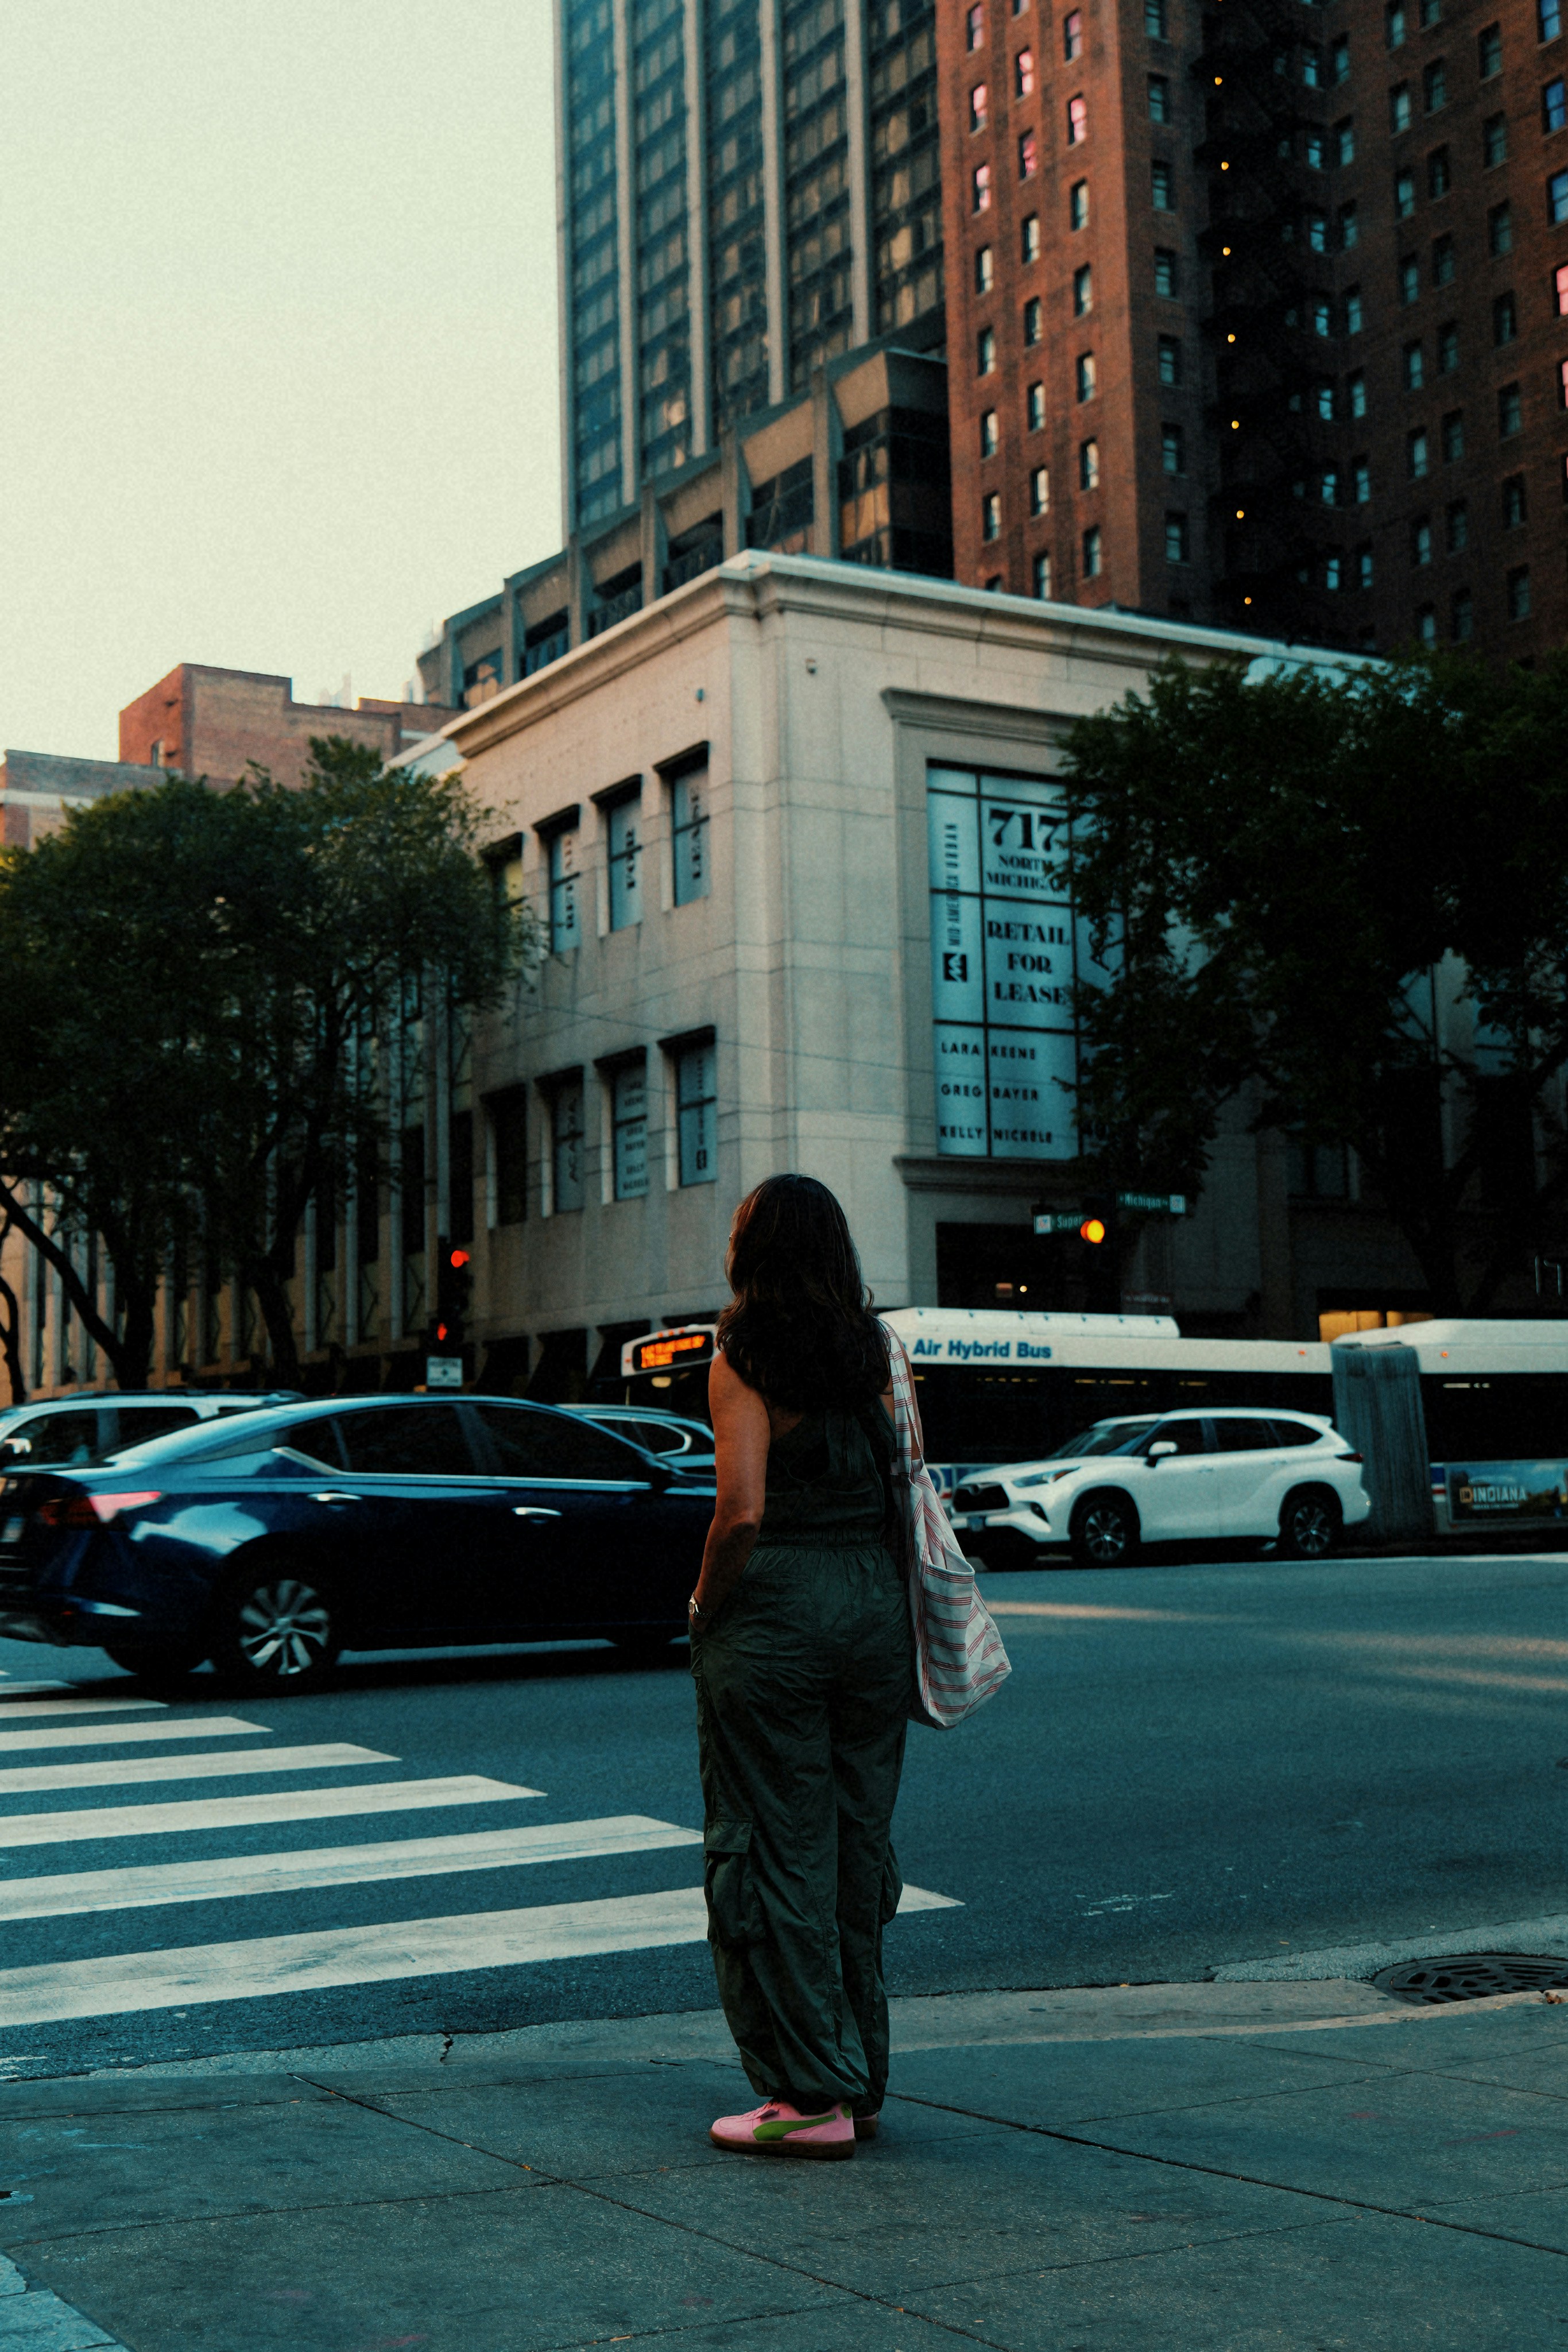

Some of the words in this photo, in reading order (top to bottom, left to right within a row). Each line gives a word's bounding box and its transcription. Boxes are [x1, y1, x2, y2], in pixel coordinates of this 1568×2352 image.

[988, 808, 1064, 852] 717
[987, 920, 1070, 945] RETAIL
[1007, 953, 1052, 973] FOR
[994, 981, 1067, 1005] LEASE
[941, 1042, 979, 1055] LARA
[990, 1045, 1036, 1060] KEENE
[940, 1083, 982, 1098] GREG
[940, 1125, 982, 1139] KELLY
[1125, 1192, 1162, 1210] Michigan
[913, 1339, 942, 1356] Air
[948, 1340, 1011, 1360] Hybrid
[1017, 1341, 1052, 1358] Bus
[1473, 1486, 1528, 1502] INDIANA
